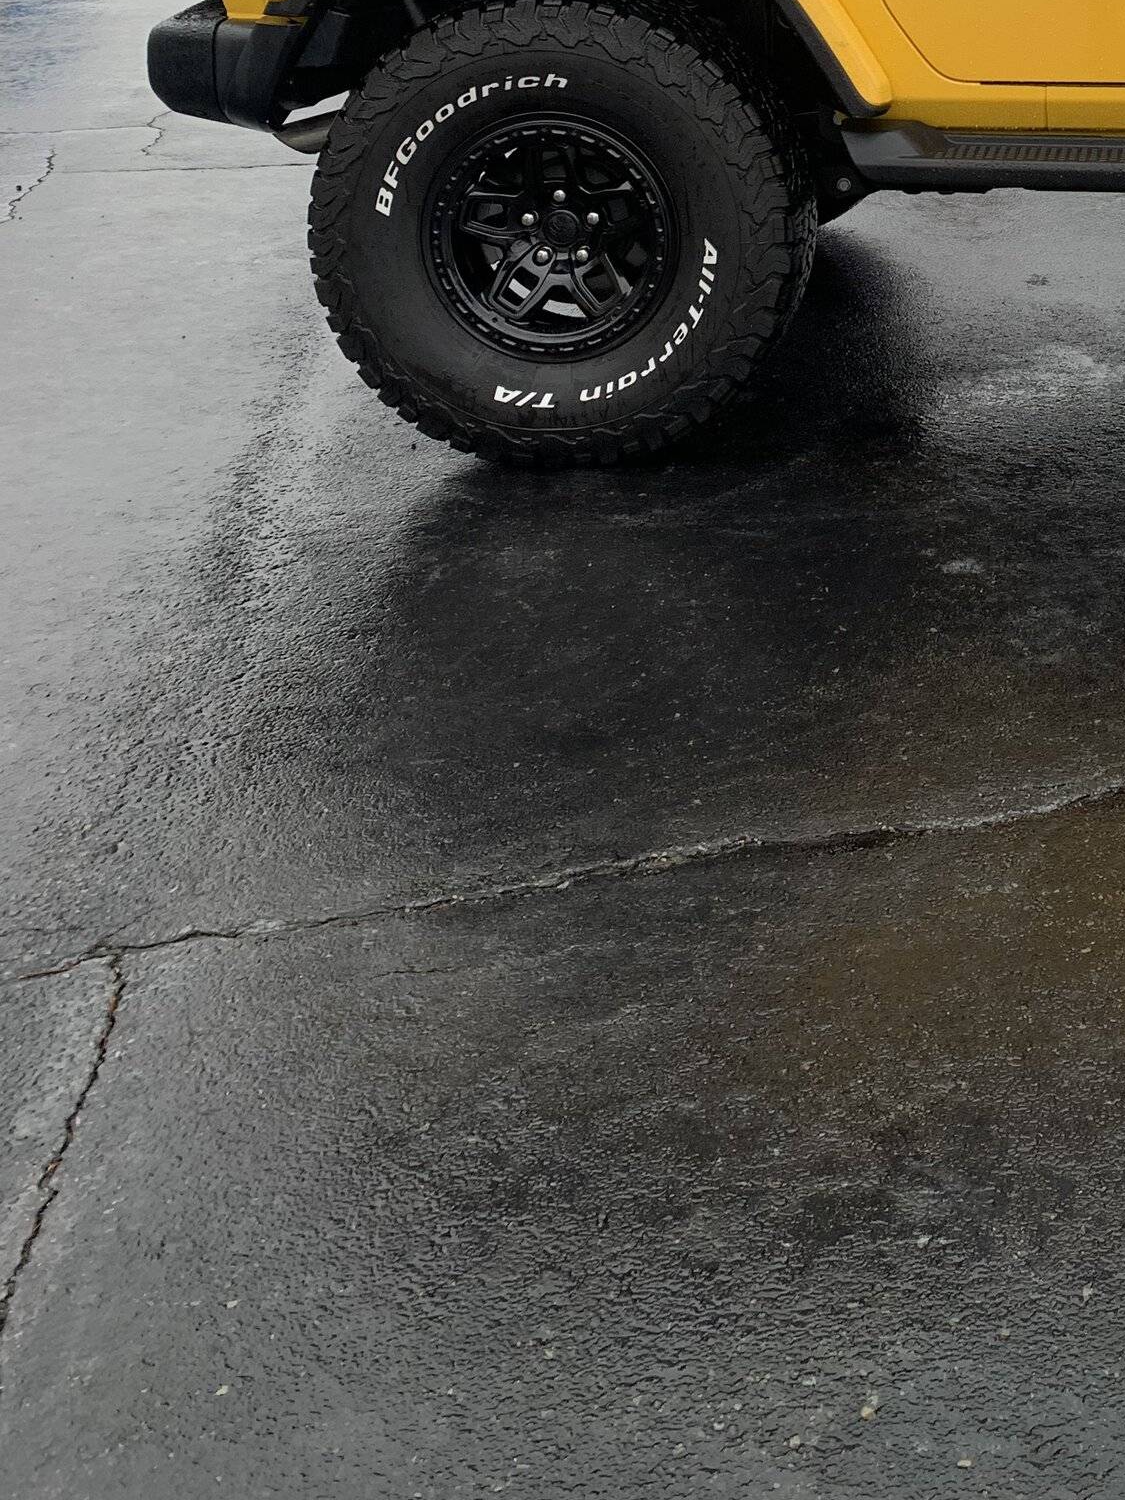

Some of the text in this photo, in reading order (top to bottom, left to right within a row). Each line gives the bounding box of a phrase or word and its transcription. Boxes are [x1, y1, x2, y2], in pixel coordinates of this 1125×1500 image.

[375, 73, 569, 217] BFGoodrich
[493, 237, 719, 408] All-Terrain T/A
